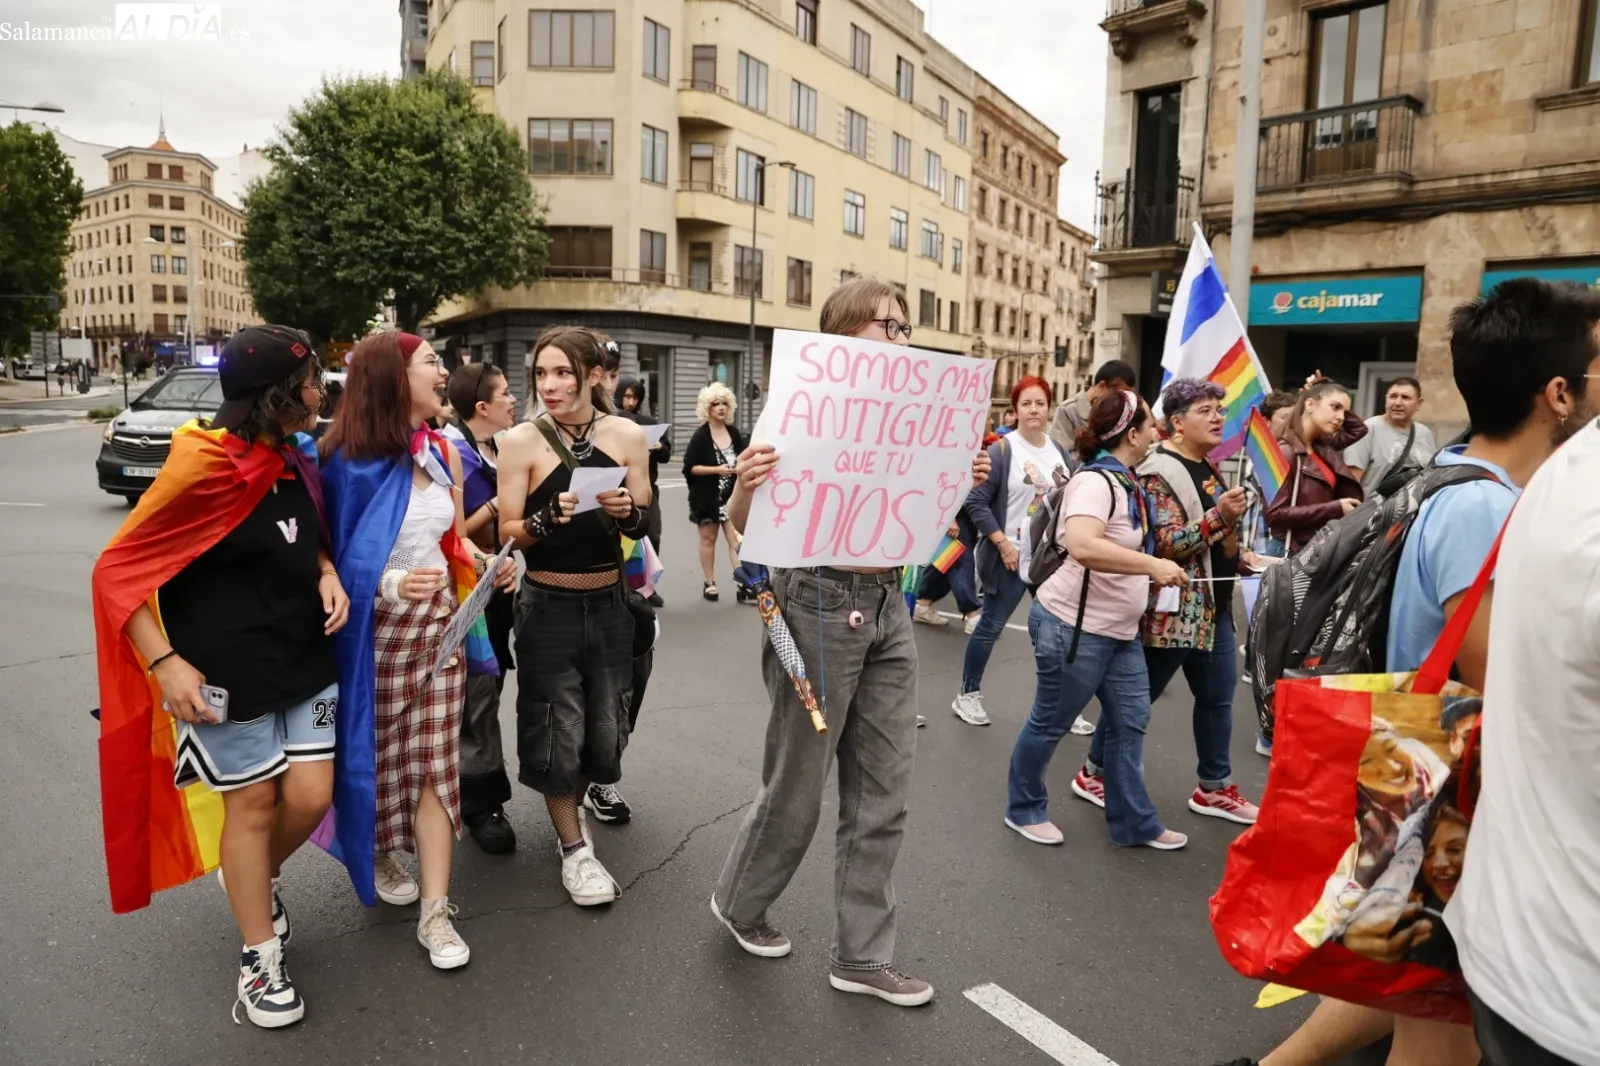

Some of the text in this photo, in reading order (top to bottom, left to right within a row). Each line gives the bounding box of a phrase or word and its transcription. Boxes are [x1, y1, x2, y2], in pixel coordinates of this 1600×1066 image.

[1297, 289, 1384, 314] cajamar
[796, 342, 993, 405] SOMOS MÁS
[779, 389, 986, 451] ANTIGÜES
[834, 450, 914, 476] QUE TU
[801, 483, 925, 561] DIOS
